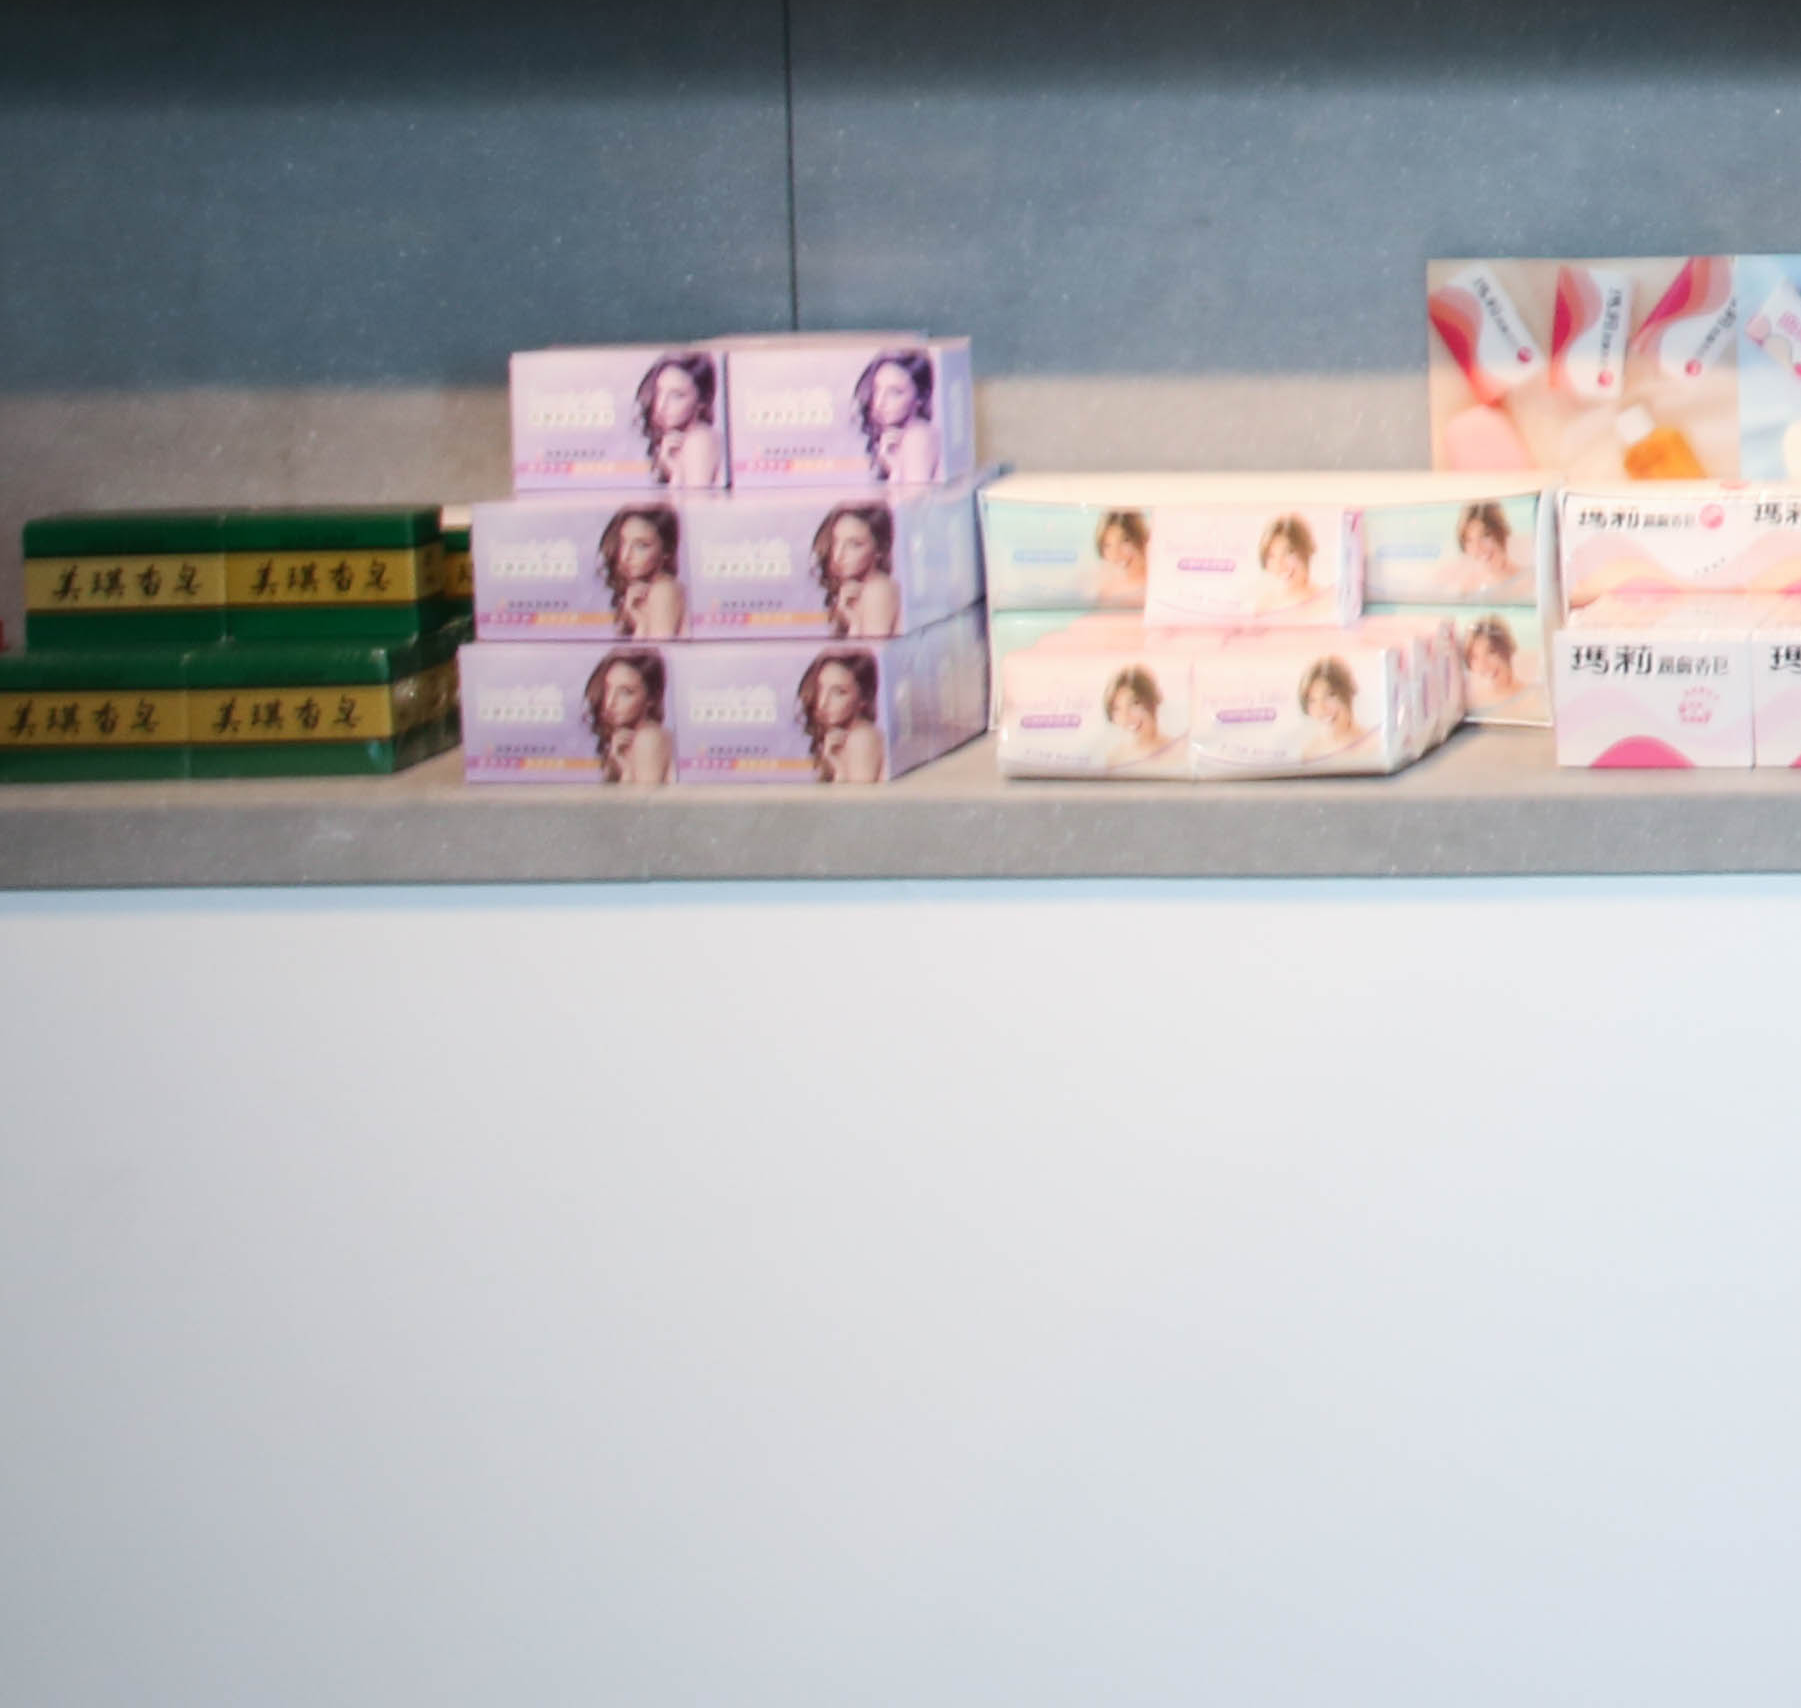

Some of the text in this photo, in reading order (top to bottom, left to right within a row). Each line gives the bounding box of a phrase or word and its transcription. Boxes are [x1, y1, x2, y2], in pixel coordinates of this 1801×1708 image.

[52, 563, 203, 602] 美琪香皂
[251, 559, 392, 602] 美琪香皂
[7, 699, 160, 738] 美琪香皂
[212, 696, 364, 734] 美琪香皂
